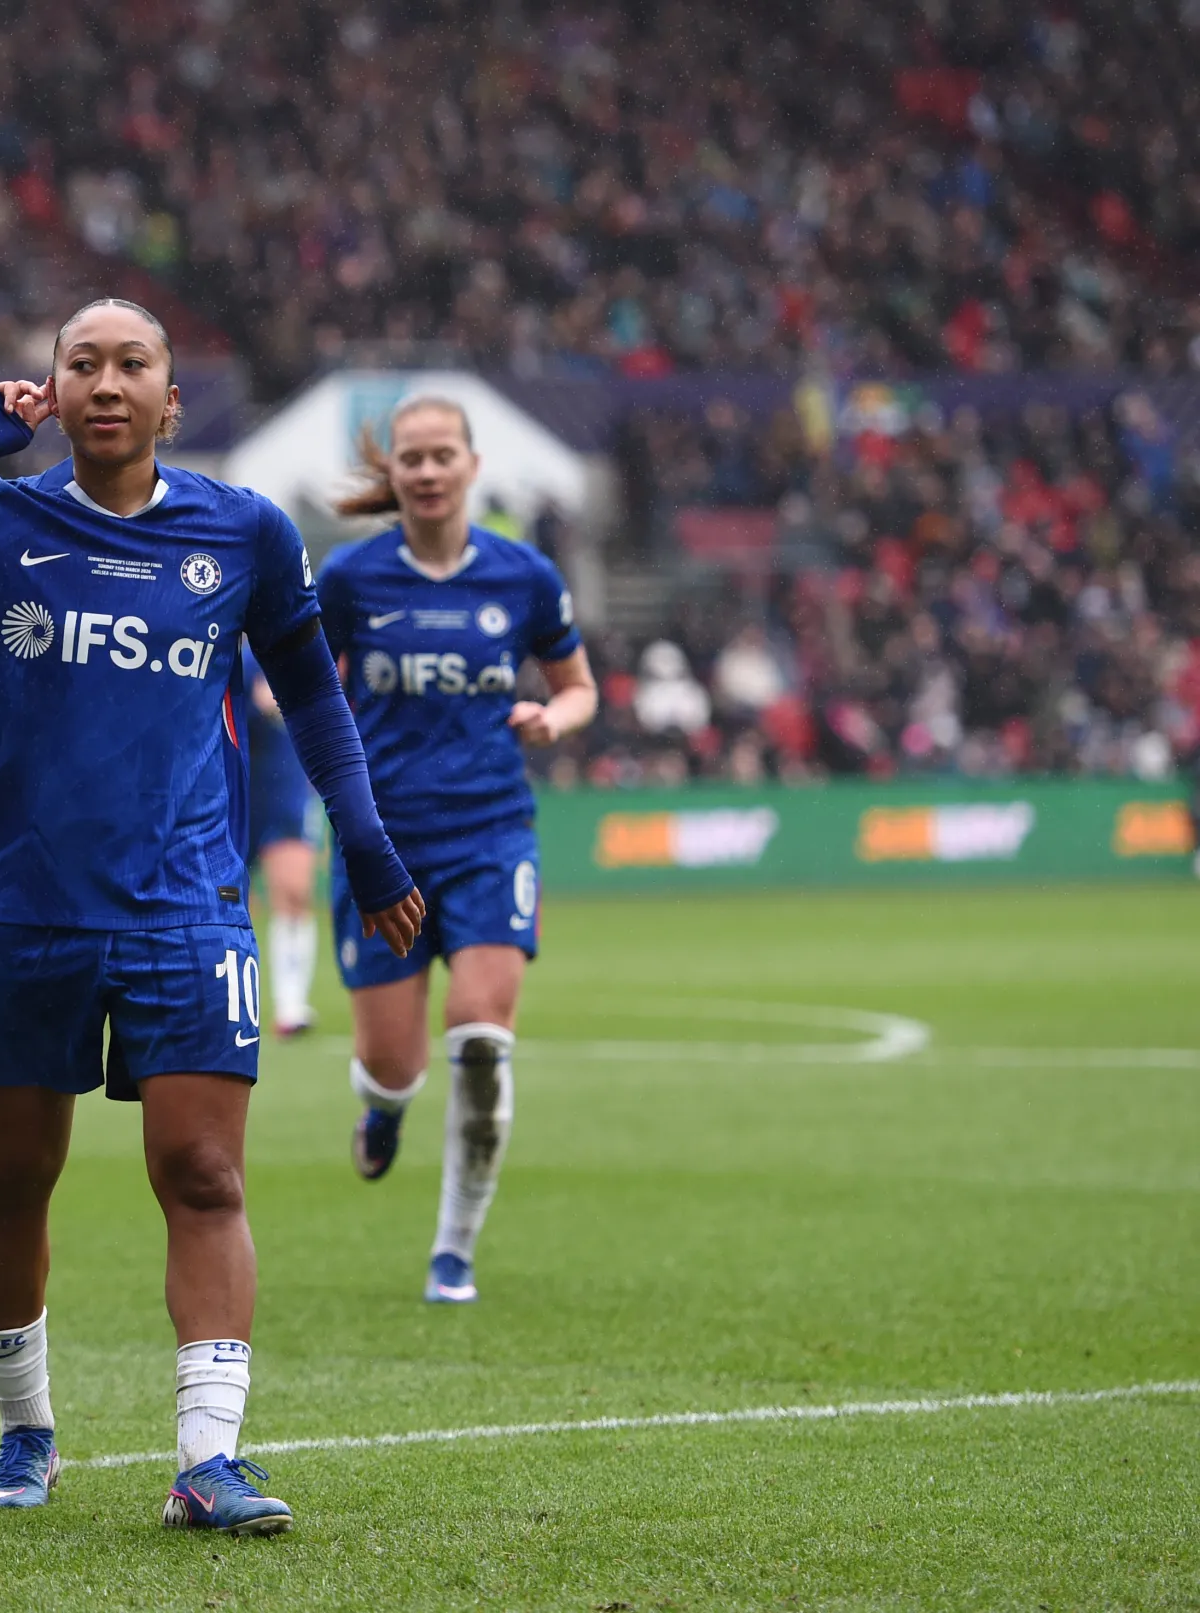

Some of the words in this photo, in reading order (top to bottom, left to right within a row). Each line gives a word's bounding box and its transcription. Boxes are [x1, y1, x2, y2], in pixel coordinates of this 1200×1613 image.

[61, 610, 219, 680] IFS.ai
[400, 651, 516, 696] IFS.ai
[215, 949, 260, 1028] 10
